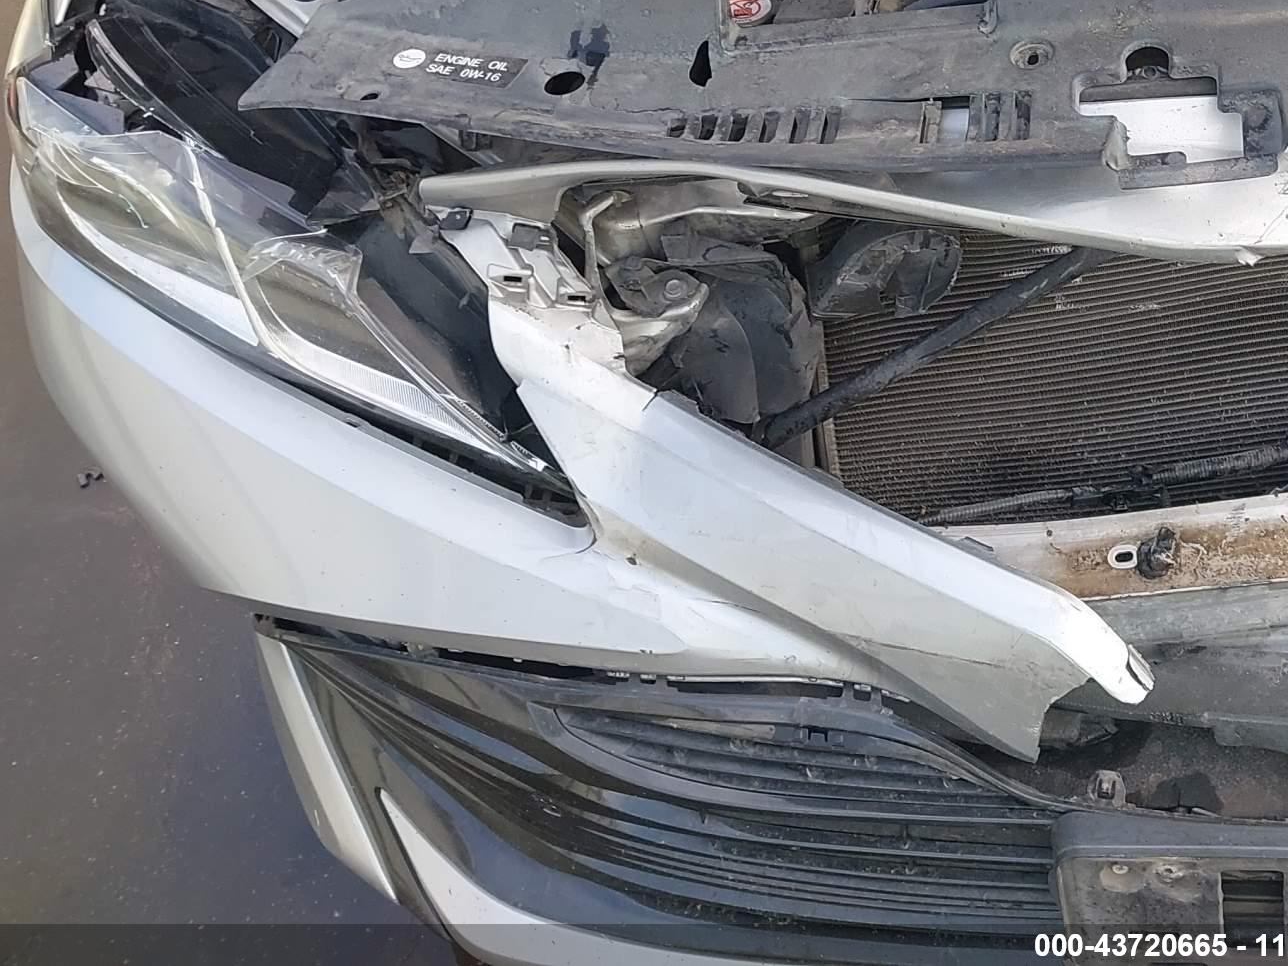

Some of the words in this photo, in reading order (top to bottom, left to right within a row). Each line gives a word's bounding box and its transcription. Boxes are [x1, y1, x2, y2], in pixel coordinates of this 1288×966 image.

[434, 53, 485, 68] ENGINE
[488, 61, 509, 71] OIL
[426, 63, 456, 75] SAE
[459, 69, 502, 81] 0W-16
